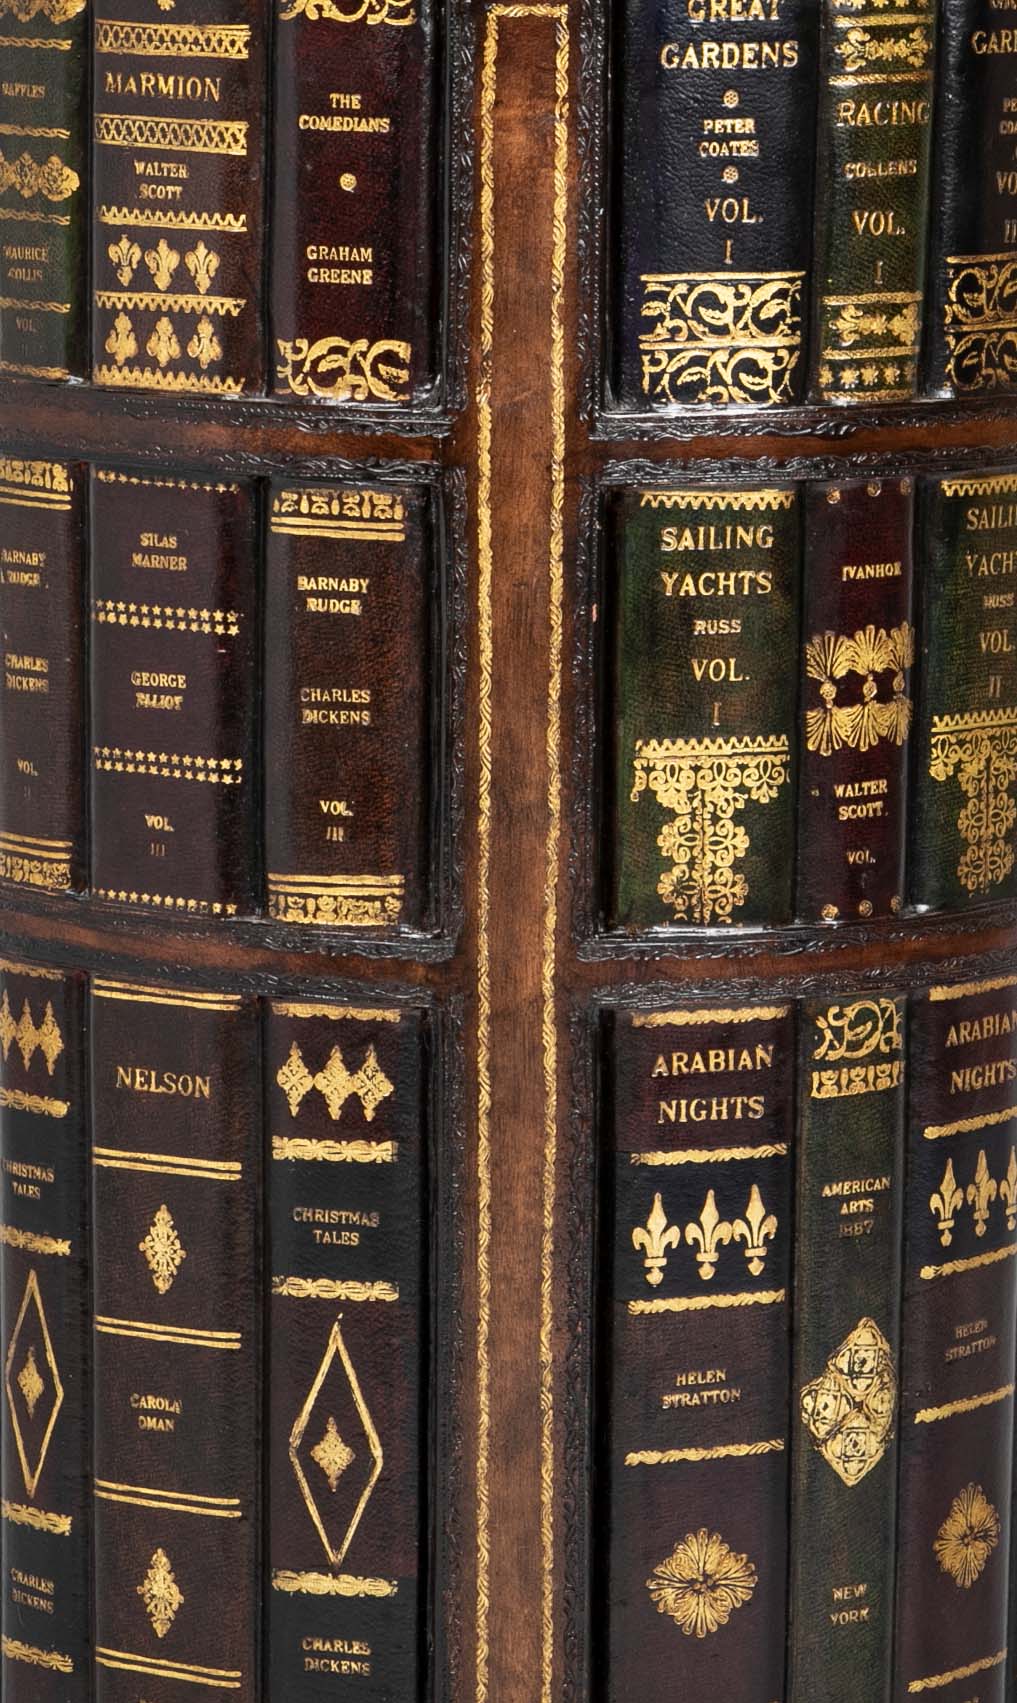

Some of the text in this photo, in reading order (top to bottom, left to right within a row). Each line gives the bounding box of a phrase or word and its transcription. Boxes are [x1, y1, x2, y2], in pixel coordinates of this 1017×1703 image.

[687, 0, 783, 23] GREAT
[971, 30, 1017, 54] GAR
[660, 40, 799, 69] GARDENS
[105, 72, 221, 101] MARMION
[330, 93, 361, 110] THE
[836, 100, 930, 126] RACING
[299, 115, 390, 132] COMEDIANS
[703, 118, 756, 135] PETER
[699, 139, 760, 158] COATES
[134, 159, 190, 179] WALTER
[138, 183, 183, 200] SCOTT
[704, 198, 764, 223] VOL.
[852, 210, 906, 236] VOL.
[2, 243, 49, 263] MAURICE
[306, 245, 373, 262] GRAHAM
[724, 239, 733, 264] I
[307, 268, 373, 285] GREENE
[966, 503, 1017, 531] SAILI
[140, 531, 178, 549] SILAS
[660, 525, 775, 551] SAILING
[0, 548, 47, 568] BARNABY
[131, 552, 188, 571] MARNER
[964, 550, 1017, 577] YACH
[297, 575, 370, 594] BARNABY
[660, 571, 772, 597] YACHTS
[306, 597, 363, 615] RUDGE
[693, 619, 742, 636] RUSS
[5, 652, 49, 673] CHARLES
[691, 657, 750, 683] VOL.
[5, 673, 49, 693] DICKENS
[130, 671, 187, 689] GEORGE
[300, 687, 371, 703] CHARLES
[302, 709, 371, 726] DICKENS
[711, 701, 721, 727] I
[833, 778, 888, 798] WALTER
[144, 813, 175, 833] VOL.
[651, 1044, 774, 1078] ARABIAN
[116, 1066, 211, 1099] NELSON
[950, 1058, 1017, 1095] NIGHTS
[657, 1095, 765, 1125] NIGHTS
[12, 1181, 41, 1200] TALES
[821, 1176, 891, 1198] AMERICAN
[840, 1198, 874, 1216] ARTS
[292, 1207, 380, 1228] CHRISTMAS
[313, 1229, 360, 1246] TALES
[675, 1368, 727, 1387] HELEN
[661, 1387, 741, 1409] STRATTON
[138, 1415, 175, 1433] OMAN
[10, 1567, 55, 1596] CHARLES
[832, 1584, 868, 1602] NEW
[830, 1607, 869, 1626] YORK
[302, 1636, 372, 1656] CHARLES
[303, 1657, 372, 1677] DICKENS
